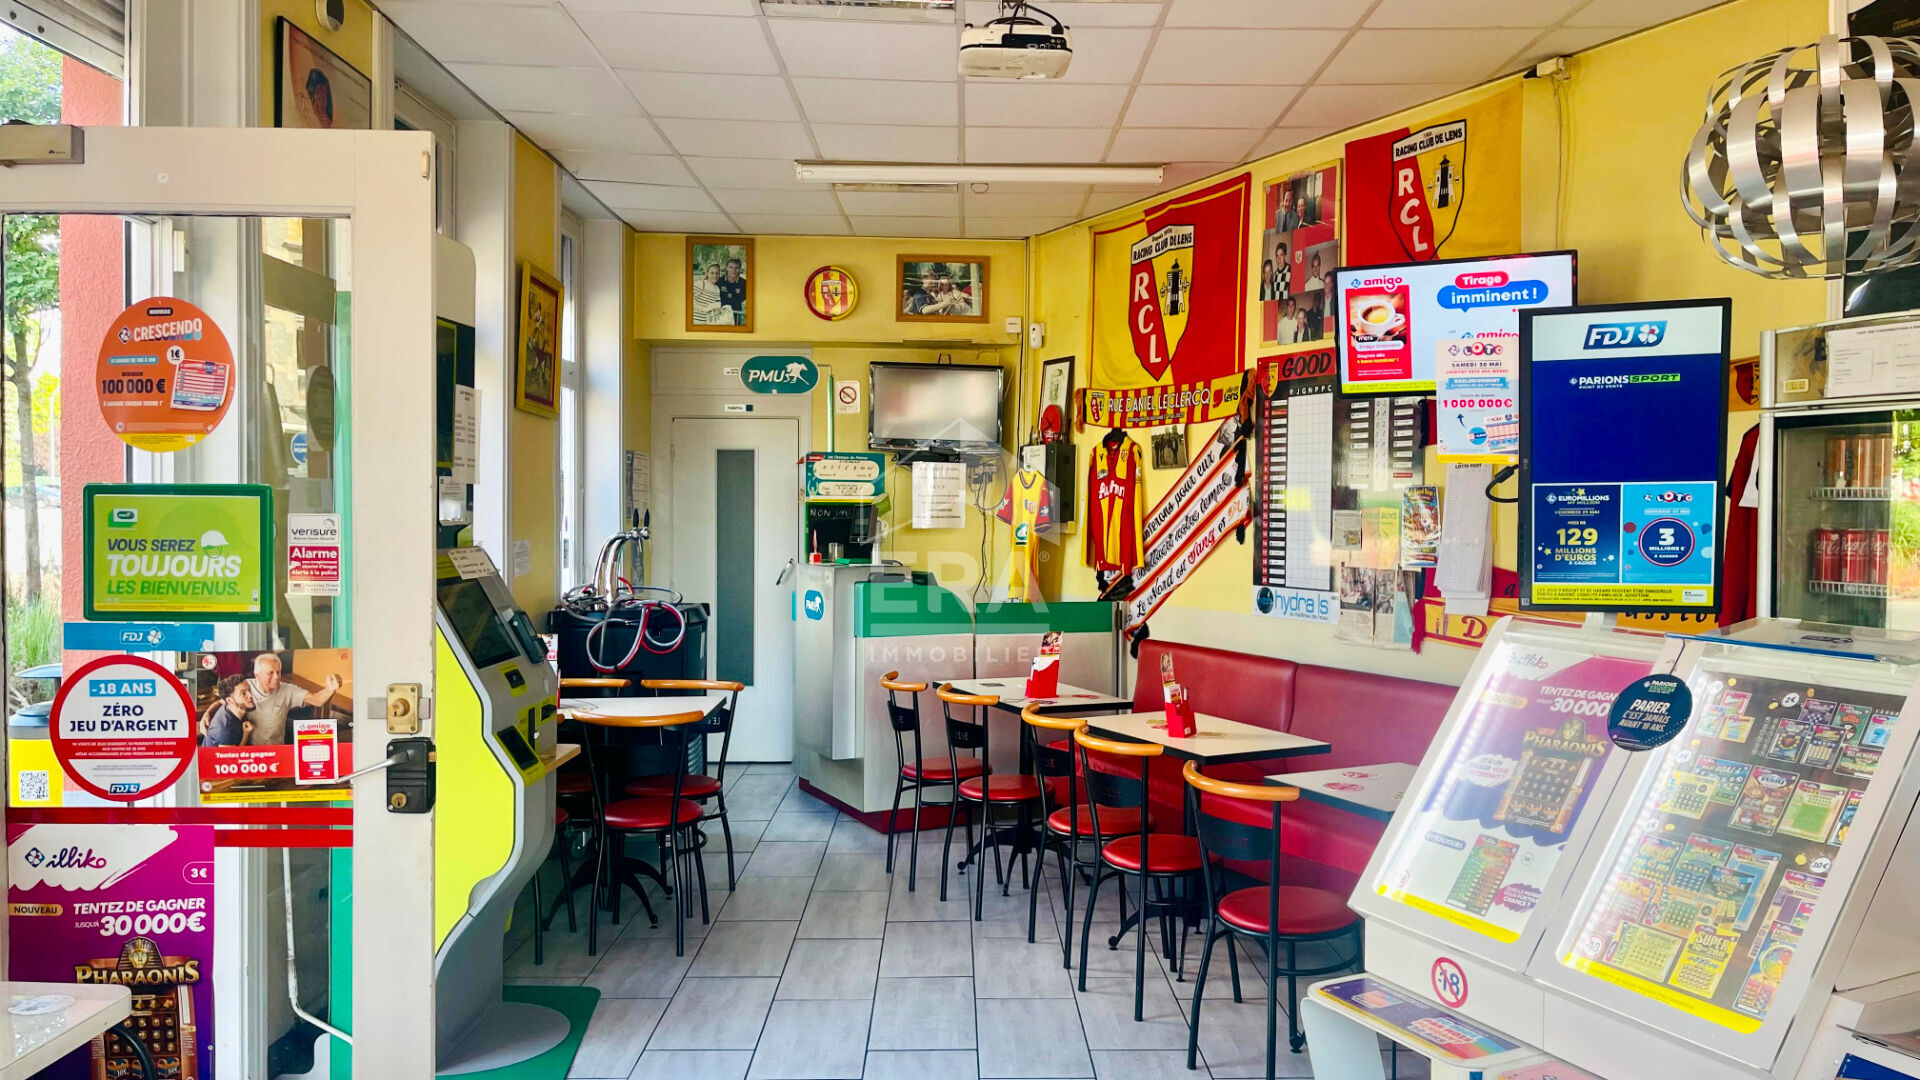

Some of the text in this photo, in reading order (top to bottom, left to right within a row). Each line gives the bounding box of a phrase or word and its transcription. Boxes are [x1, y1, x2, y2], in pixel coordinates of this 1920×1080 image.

[1396, 128, 1463, 157] RACING CLUB DE LENS
[1133, 232, 1193, 261] RACING CLUB DE LENS
[1364, 275, 1403, 293] amigo
[1462, 274, 1502, 287] Tirage
[1451, 287, 1538, 305] imminent !
[133, 318, 203, 342] CRESCENDO
[1588, 326, 1635, 346] FDJ
[171, 349, 180, 358] 1€
[1463, 341, 1503, 356] LOTO
[1282, 352, 1332, 378] GOOD
[748, 370, 785, 382] PMU
[1579, 374, 1680, 385] PARIONS SPORT
[102, 379, 165, 394] 100 000 €
[1107, 397, 1123, 412] RUE
[1125, 395, 1156, 412] DANIEL
[1158, 388, 1211, 409] LECLERCQ
[1223, 392, 1238, 402] Lens
[1451, 400, 1475, 408] 000
[1176, 476, 1197, 508] pour
[1196, 451, 1215, 476] eux
[1558, 494, 1609, 502] EUROMILLIONS
[1657, 491, 1693, 503] LOTO
[1556, 528, 1598, 546] 129
[1659, 528, 1675, 546] 3
[107, 539, 195, 552] VOUS SEREZ
[291, 547, 337, 558] Alarme
[1187, 528, 1216, 564] Sang
[1555, 553, 1596, 561] D'EUROS
[106, 554, 242, 577] TOUJOURS
[107, 579, 241, 596] LES BIENVENUS.
[1275, 590, 1315, 615] hydra
[1462, 616, 1488, 639] D
[122, 632, 143, 641] FDJ
[91, 682, 152, 694] -18 ANS
[1540, 685, 1619, 701] TENTEZ DE GAGN
[103, 702, 144, 717] ZÉRO
[1549, 698, 1611, 717] 30 000
[1630, 699, 1671, 715] PARIER,
[70, 719, 178, 732] JEU D'ARGENT
[307, 722, 331, 732] amigo
[1522, 731, 1608, 757] PHARAONIS
[214, 764, 238, 774] 100
[240, 763, 267, 773] 000
[111, 785, 128, 793] FDJ
[46, 846, 107, 869] illiko
[190, 867, 207, 879] 3€
[13, 905, 58, 915] NOUVEAU
[73, 897, 206, 915] TENTEZ DE GAGNER
[99, 914, 133, 937] 30
[74, 959, 201, 985] PHARAONIS
